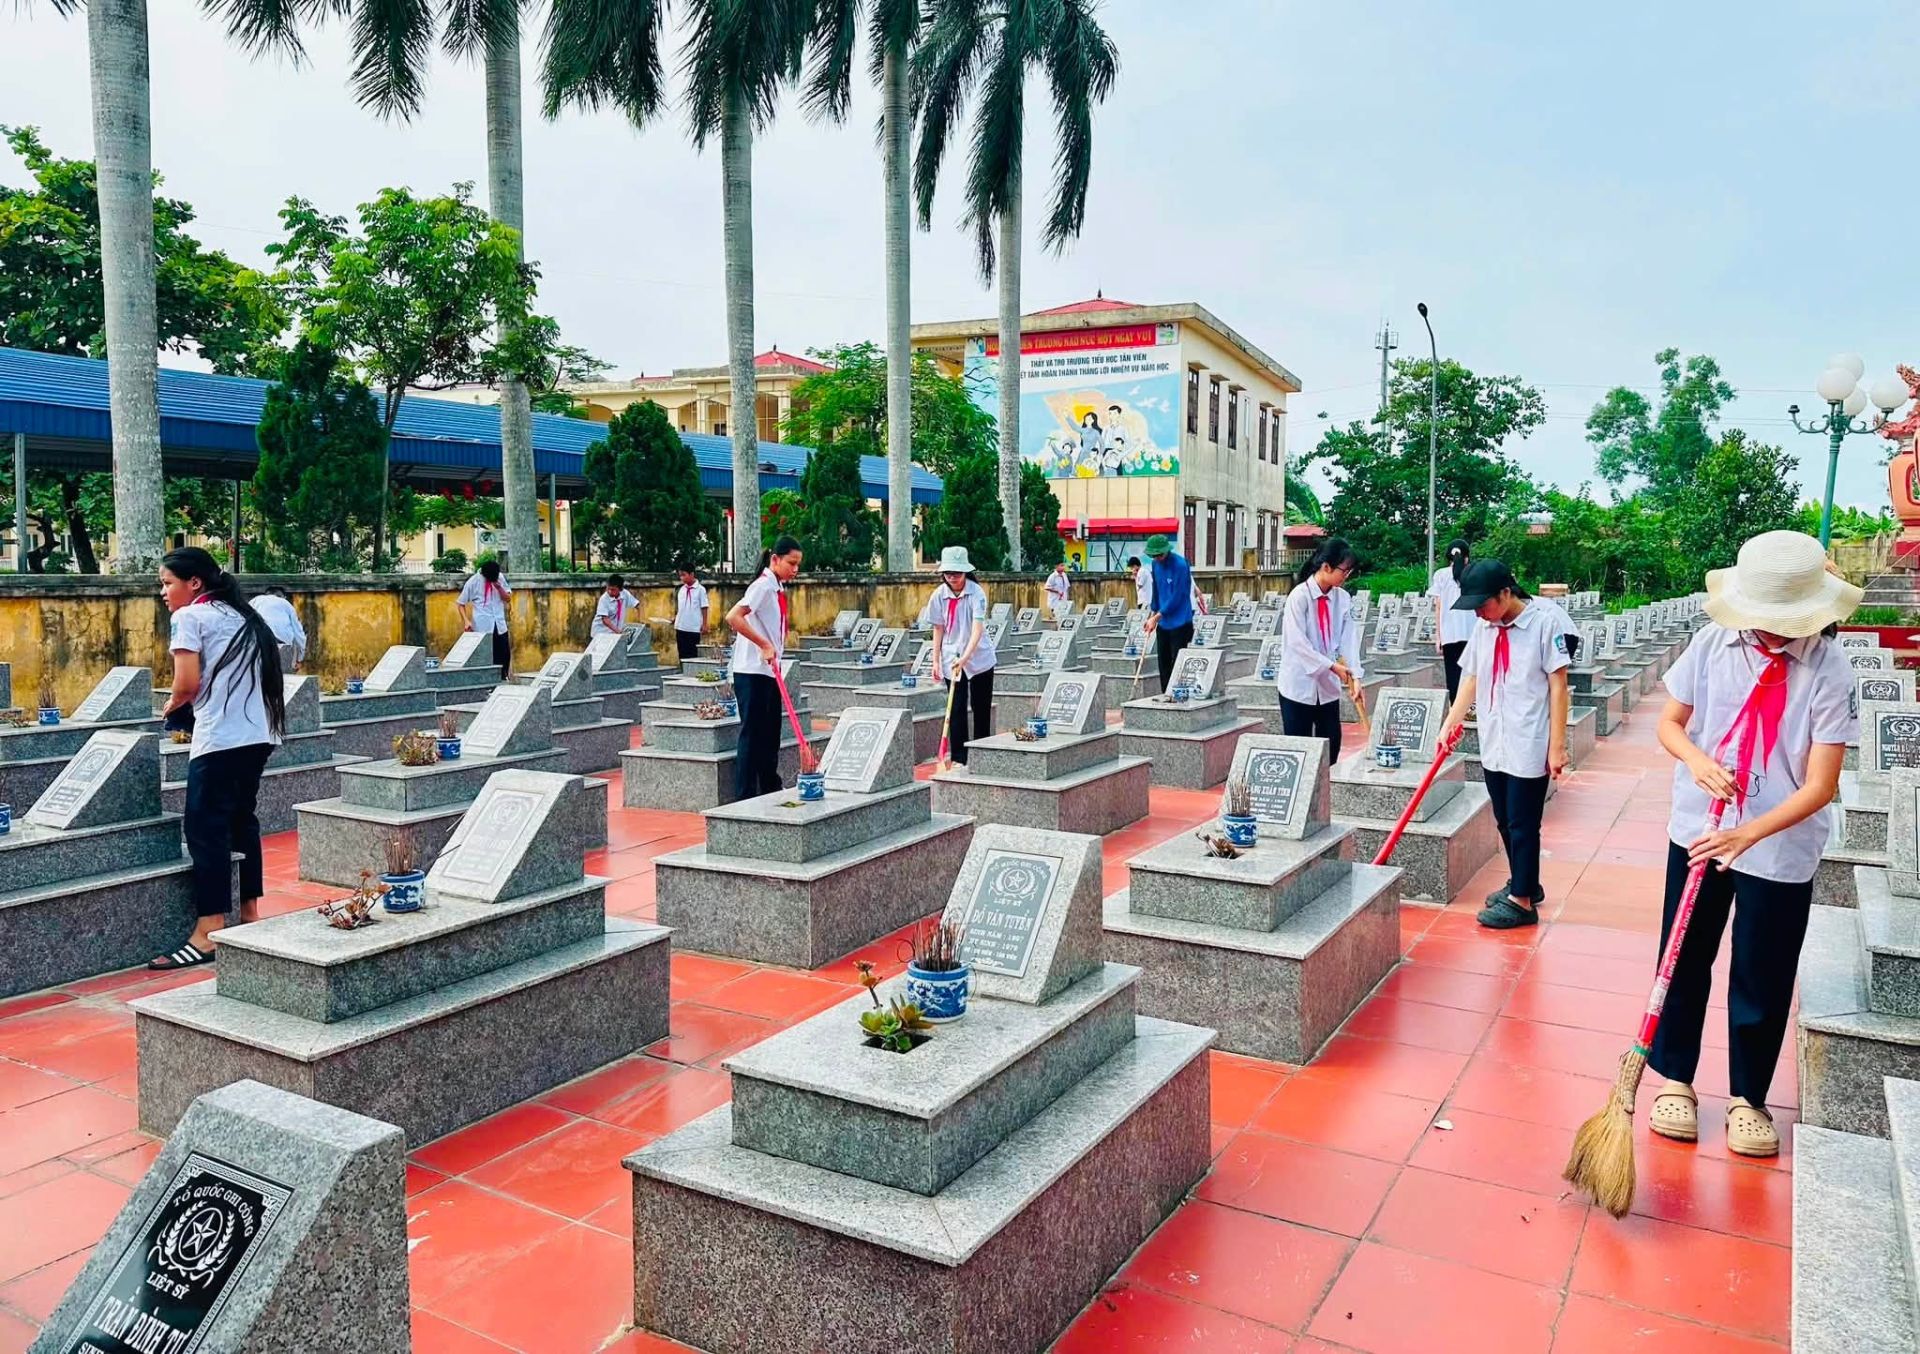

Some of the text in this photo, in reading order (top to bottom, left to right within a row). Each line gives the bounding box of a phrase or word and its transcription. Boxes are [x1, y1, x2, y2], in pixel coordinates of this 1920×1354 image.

[1136, 330, 1152, 342] VUI
[173, 1181, 255, 1238] TỔ QUỐC GHI CÔNG
[146, 1270, 191, 1300] LIỆT SỸ
[93, 1286, 141, 1340] TRẦN
[123, 1306, 171, 1354] ĐÌNH
